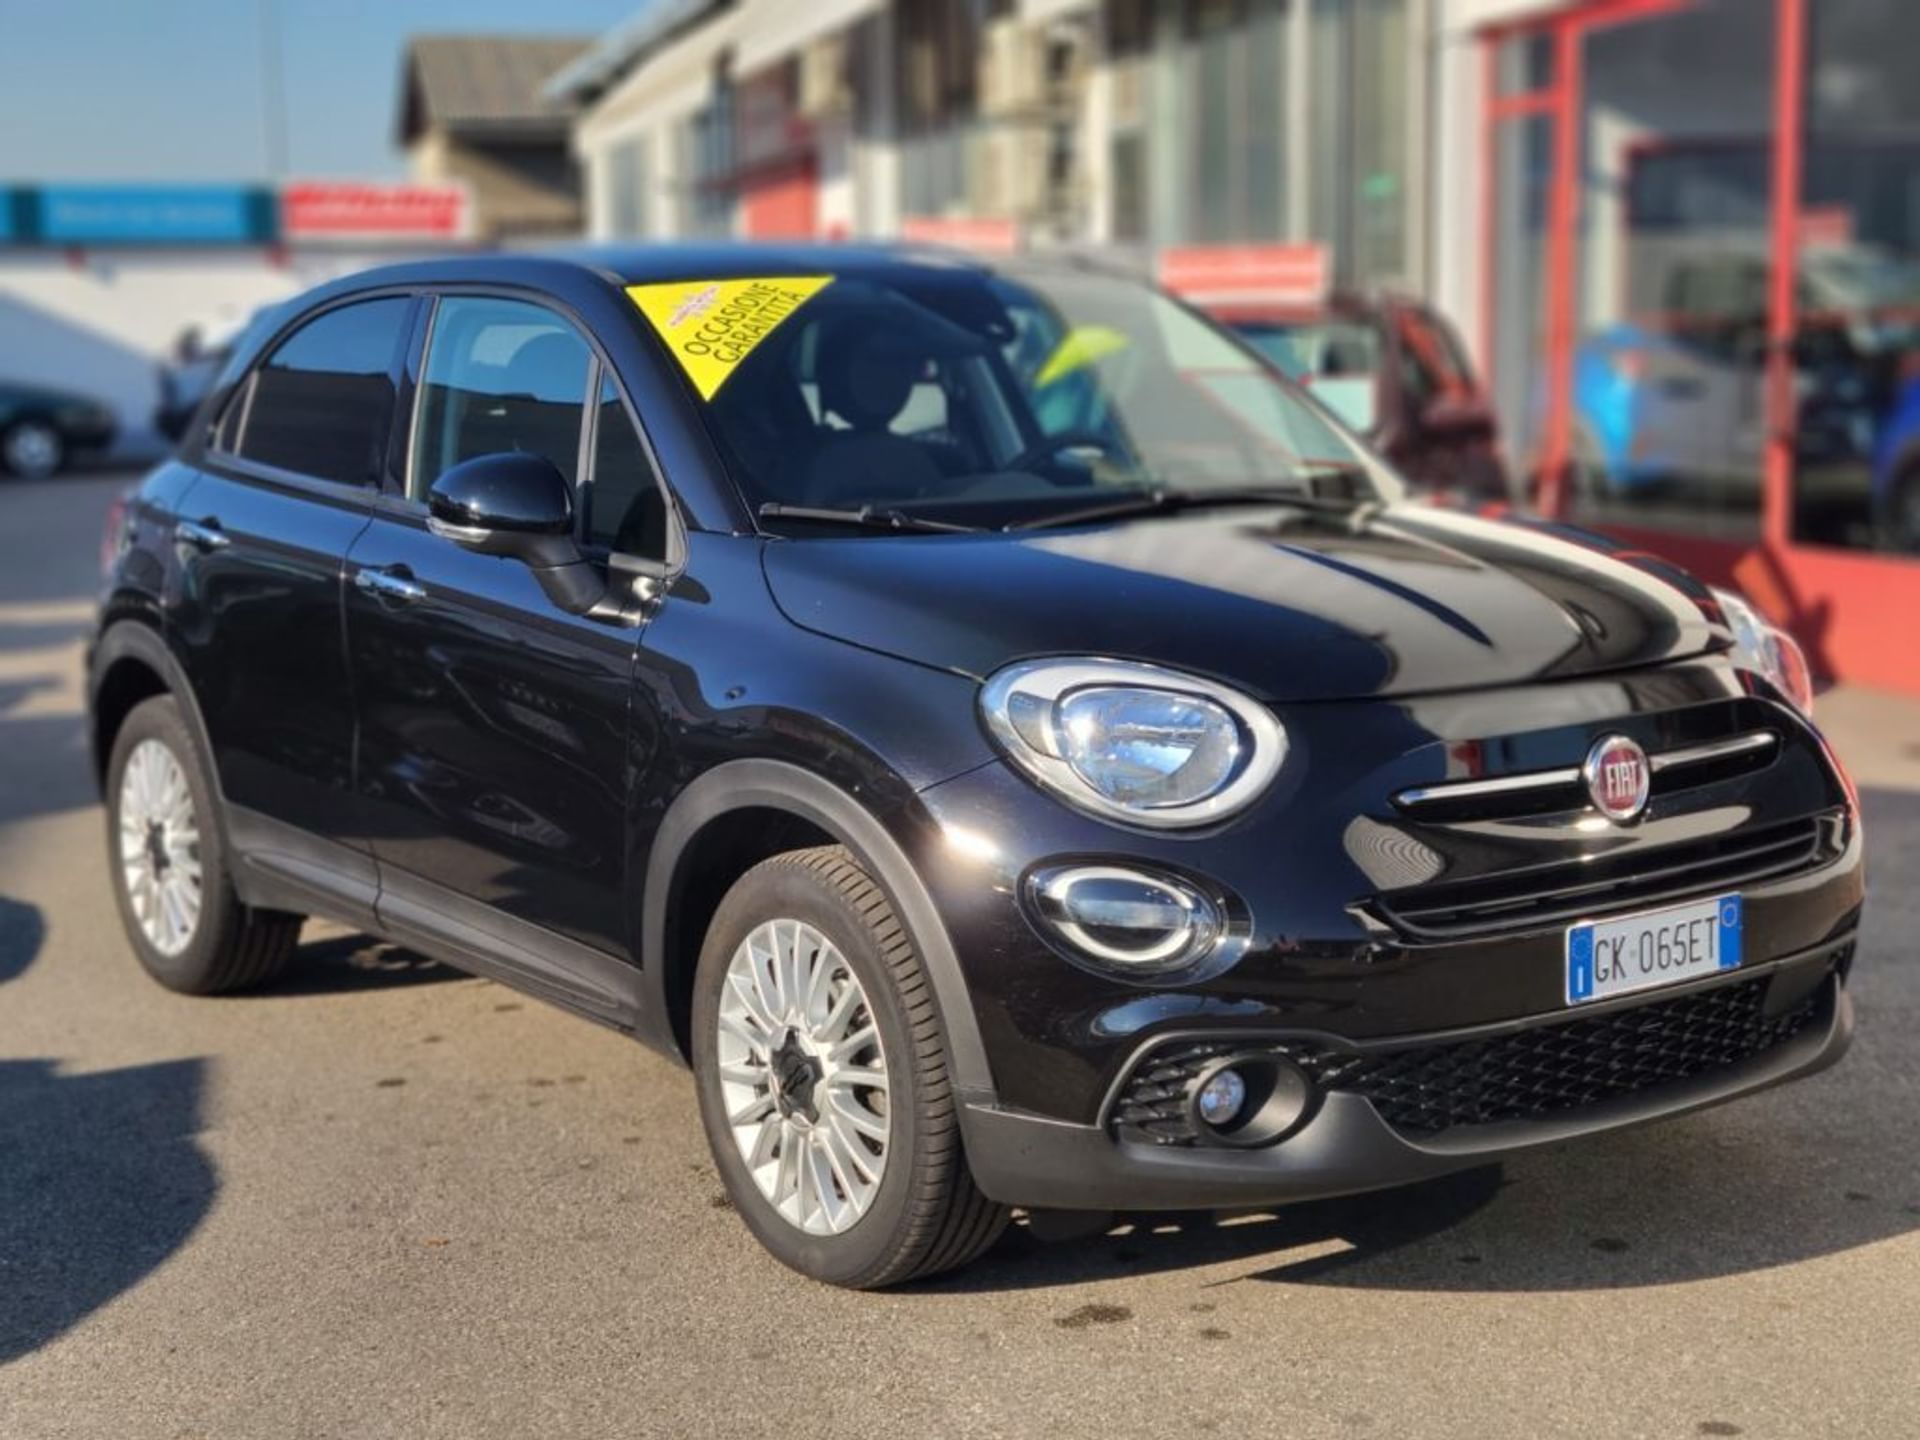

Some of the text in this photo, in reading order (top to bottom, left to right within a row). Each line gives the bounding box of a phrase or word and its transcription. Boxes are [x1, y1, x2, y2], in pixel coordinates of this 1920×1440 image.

[684, 283, 779, 355] OCCASIONE
[713, 290, 802, 363] GARANTITA
[1605, 761, 1638, 800] FIAT
